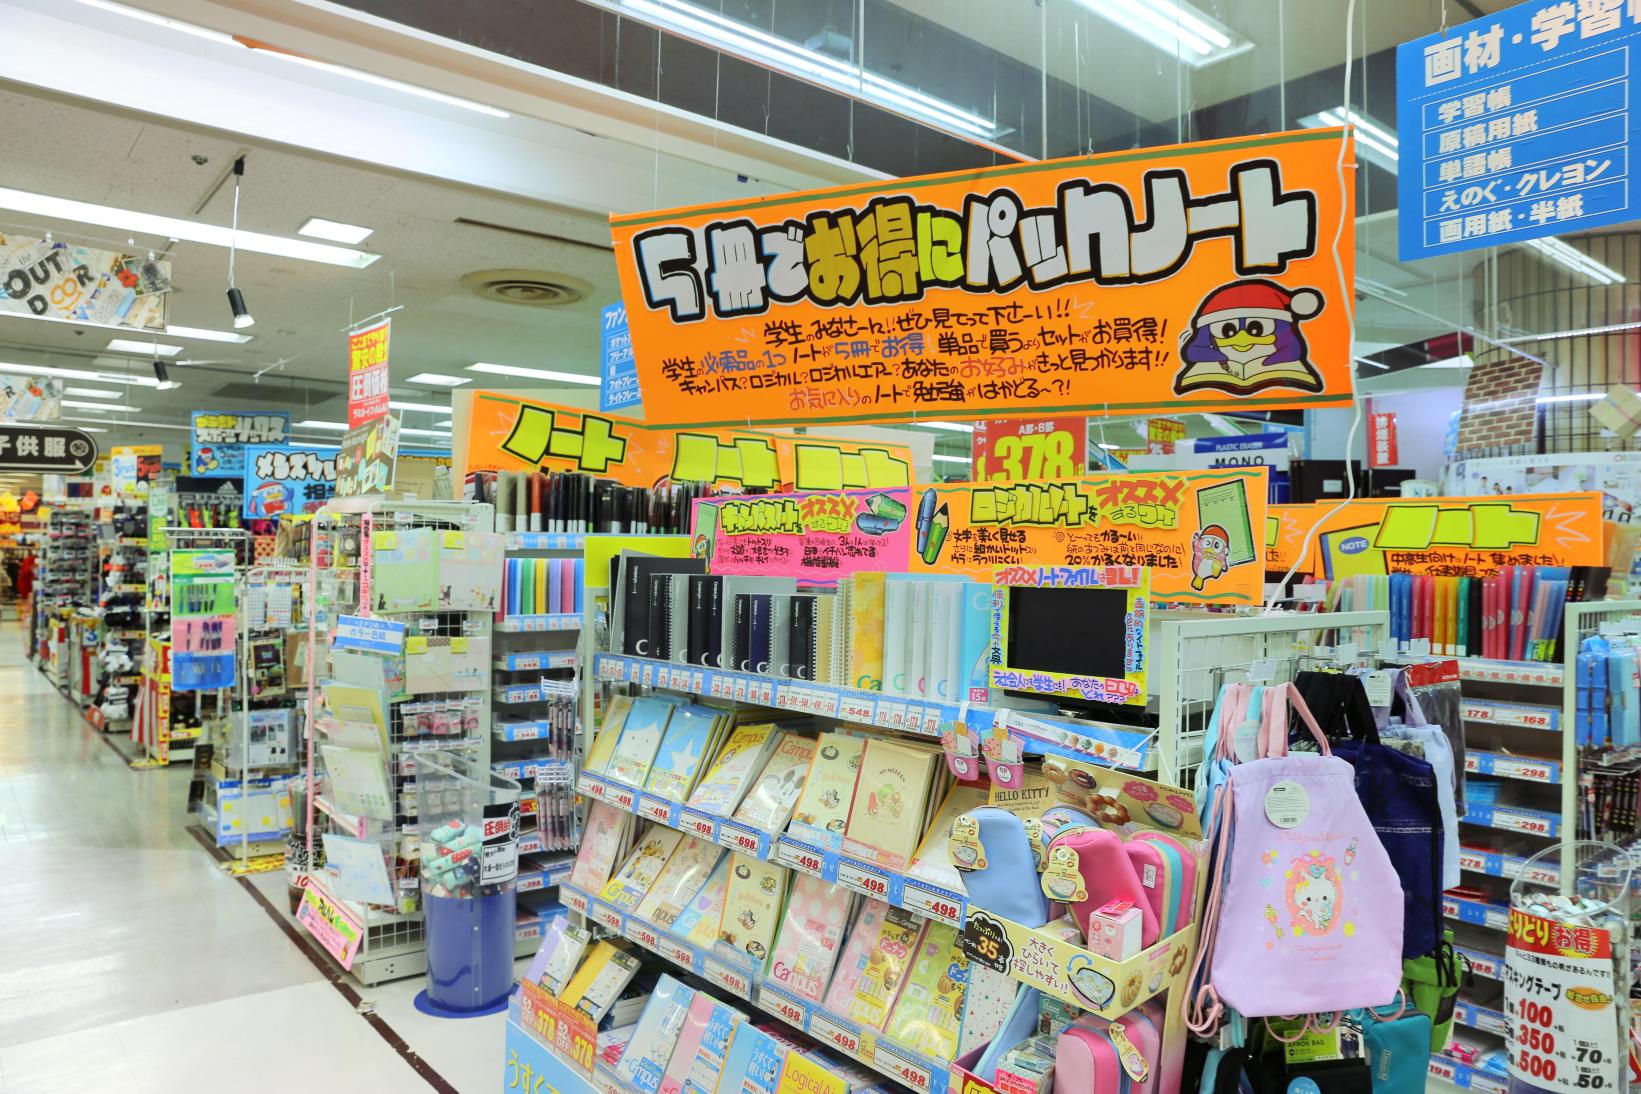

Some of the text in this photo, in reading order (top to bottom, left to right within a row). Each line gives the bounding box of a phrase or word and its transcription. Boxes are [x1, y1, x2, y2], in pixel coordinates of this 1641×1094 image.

[1438, 85, 1512, 124] 学習帳
[1439, 109, 1538, 153] 原稿用紙
[1439, 147, 1513, 183] 単語帳
[1440, 159, 1612, 213] えのぐ・クレヨン
[1439, 194, 1584, 244] 画用紙・半紙
[5, 250, 63, 299] OUT
[1215, 442, 1239, 451] PLASTIC
[993, 430, 1075, 482] 378
[1215, 455, 1265, 467] MONO
[1097, 479, 1185, 509] オススメ
[1340, 538, 1368, 552] NOTE
[848, 707, 870, 718] 548
[1467, 709, 1489, 719] 178
[1522, 715, 1547, 725] 168
[732, 731, 765, 745] Campus
[1522, 767, 1546, 778] 298
[591, 784, 604, 796] 498
[994, 786, 1049, 803] HELLO KITTY
[618, 794, 632, 806] 498
[653, 806, 668, 820] 498
[696, 822, 712, 836] 698
[1520, 820, 1545, 832] 298
[738, 836, 756, 850] 698
[800, 855, 819, 870] 498
[1460, 858, 1482, 869] 278
[862, 877, 885, 894] 498
[931, 901, 957, 918] 498
[641, 931, 656, 946] 598
[1553, 924, 1594, 955] お得
[977, 936, 1000, 960] 35
[1029, 937, 1055, 958] 大きく
[675, 950, 691, 964] 598
[1021, 948, 1059, 976] ひらいて
[774, 961, 819, 1000] Campus
[780, 1006, 801, 1022] 498
[1519, 998, 1553, 1028] 100
[834, 1033, 856, 1050] 498
[1519, 1024, 1554, 1054] 350
[572, 1035, 594, 1069] 378
[1576, 1047, 1602, 1064] 70
[1519, 1049, 1556, 1081] 500
[785, 1059, 822, 1094] Logical
[901, 1069, 926, 1087] 498
[1577, 1074, 1604, 1089] 50
